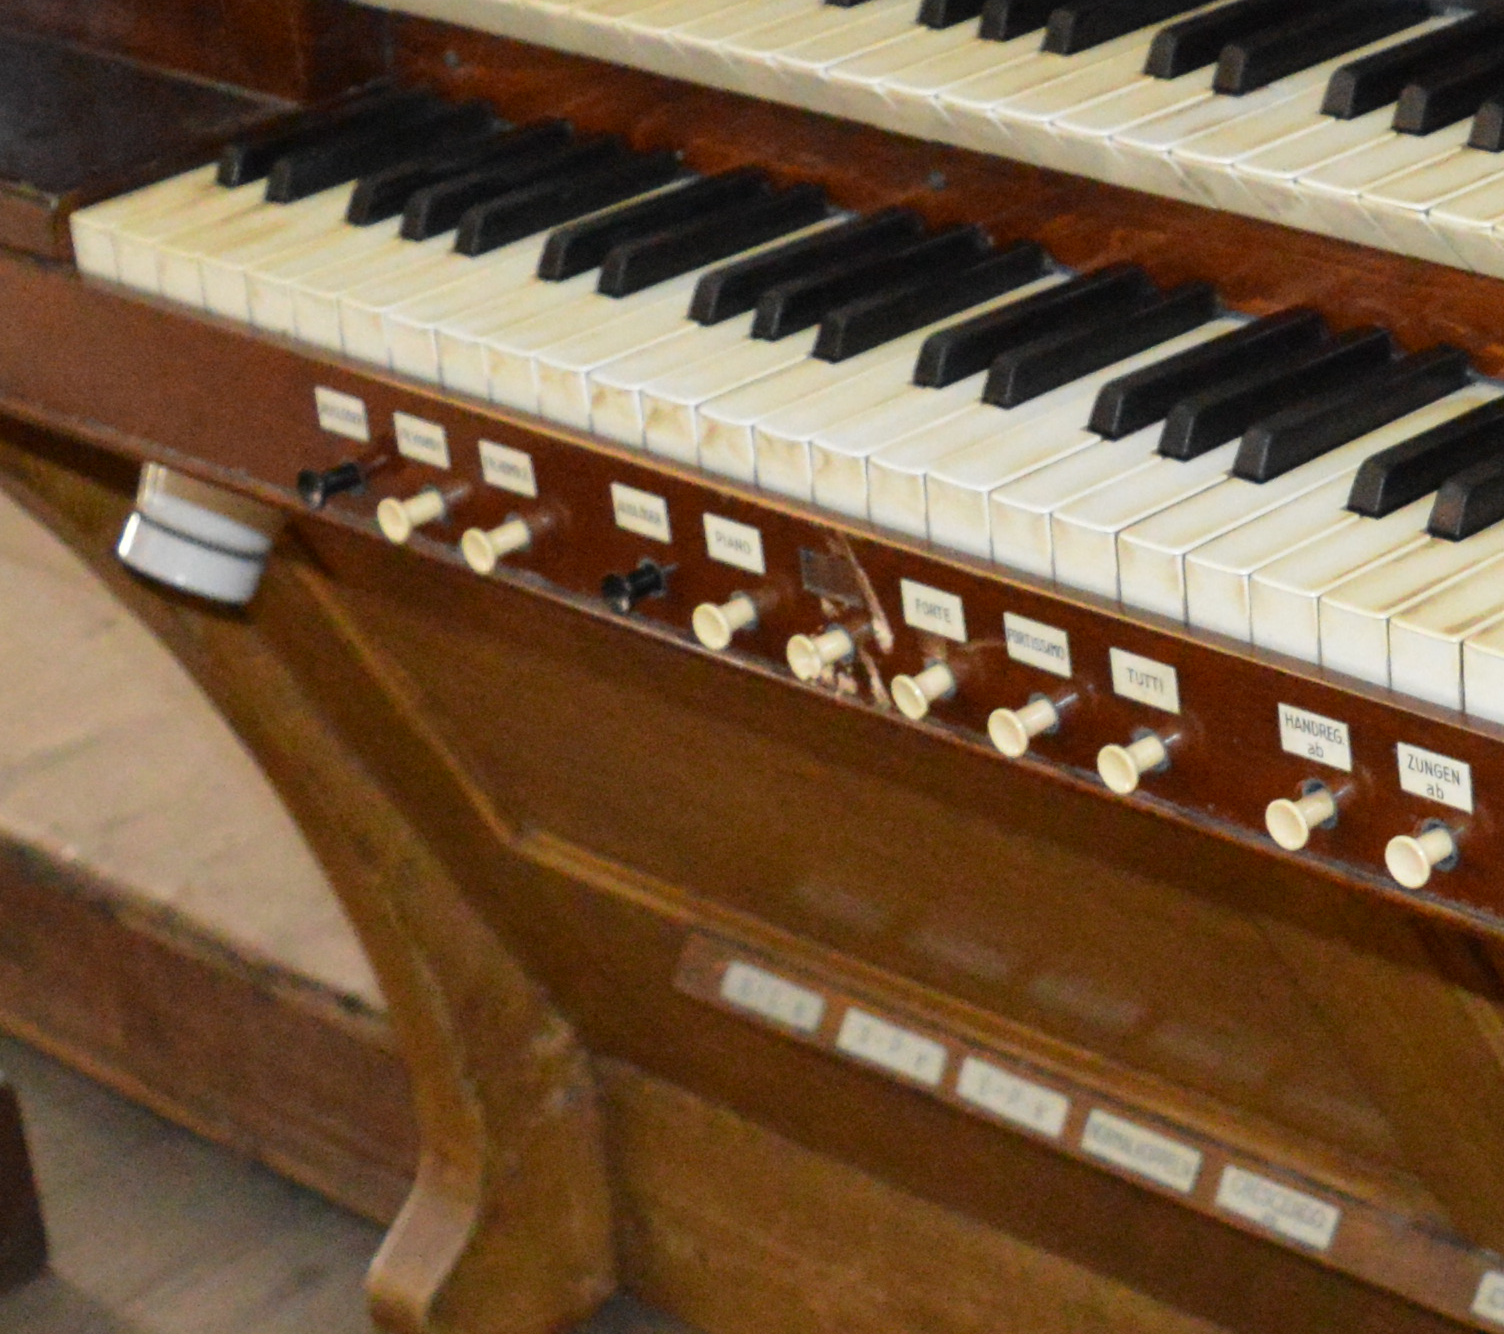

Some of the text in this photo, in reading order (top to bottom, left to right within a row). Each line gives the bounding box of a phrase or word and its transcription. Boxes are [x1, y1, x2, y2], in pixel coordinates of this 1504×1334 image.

[715, 530, 751, 554] PIANO
[915, 598, 951, 624] FORTE
[1006, 627, 1064, 659] FORTISSIMO
[1126, 667, 1163, 693] TUTTI
[1284, 709, 1346, 745] HANDREG.
[1307, 741, 1325, 758] ab
[1407, 754, 1460, 786] ZUNGEN
[1426, 781, 1444, 800] ab
